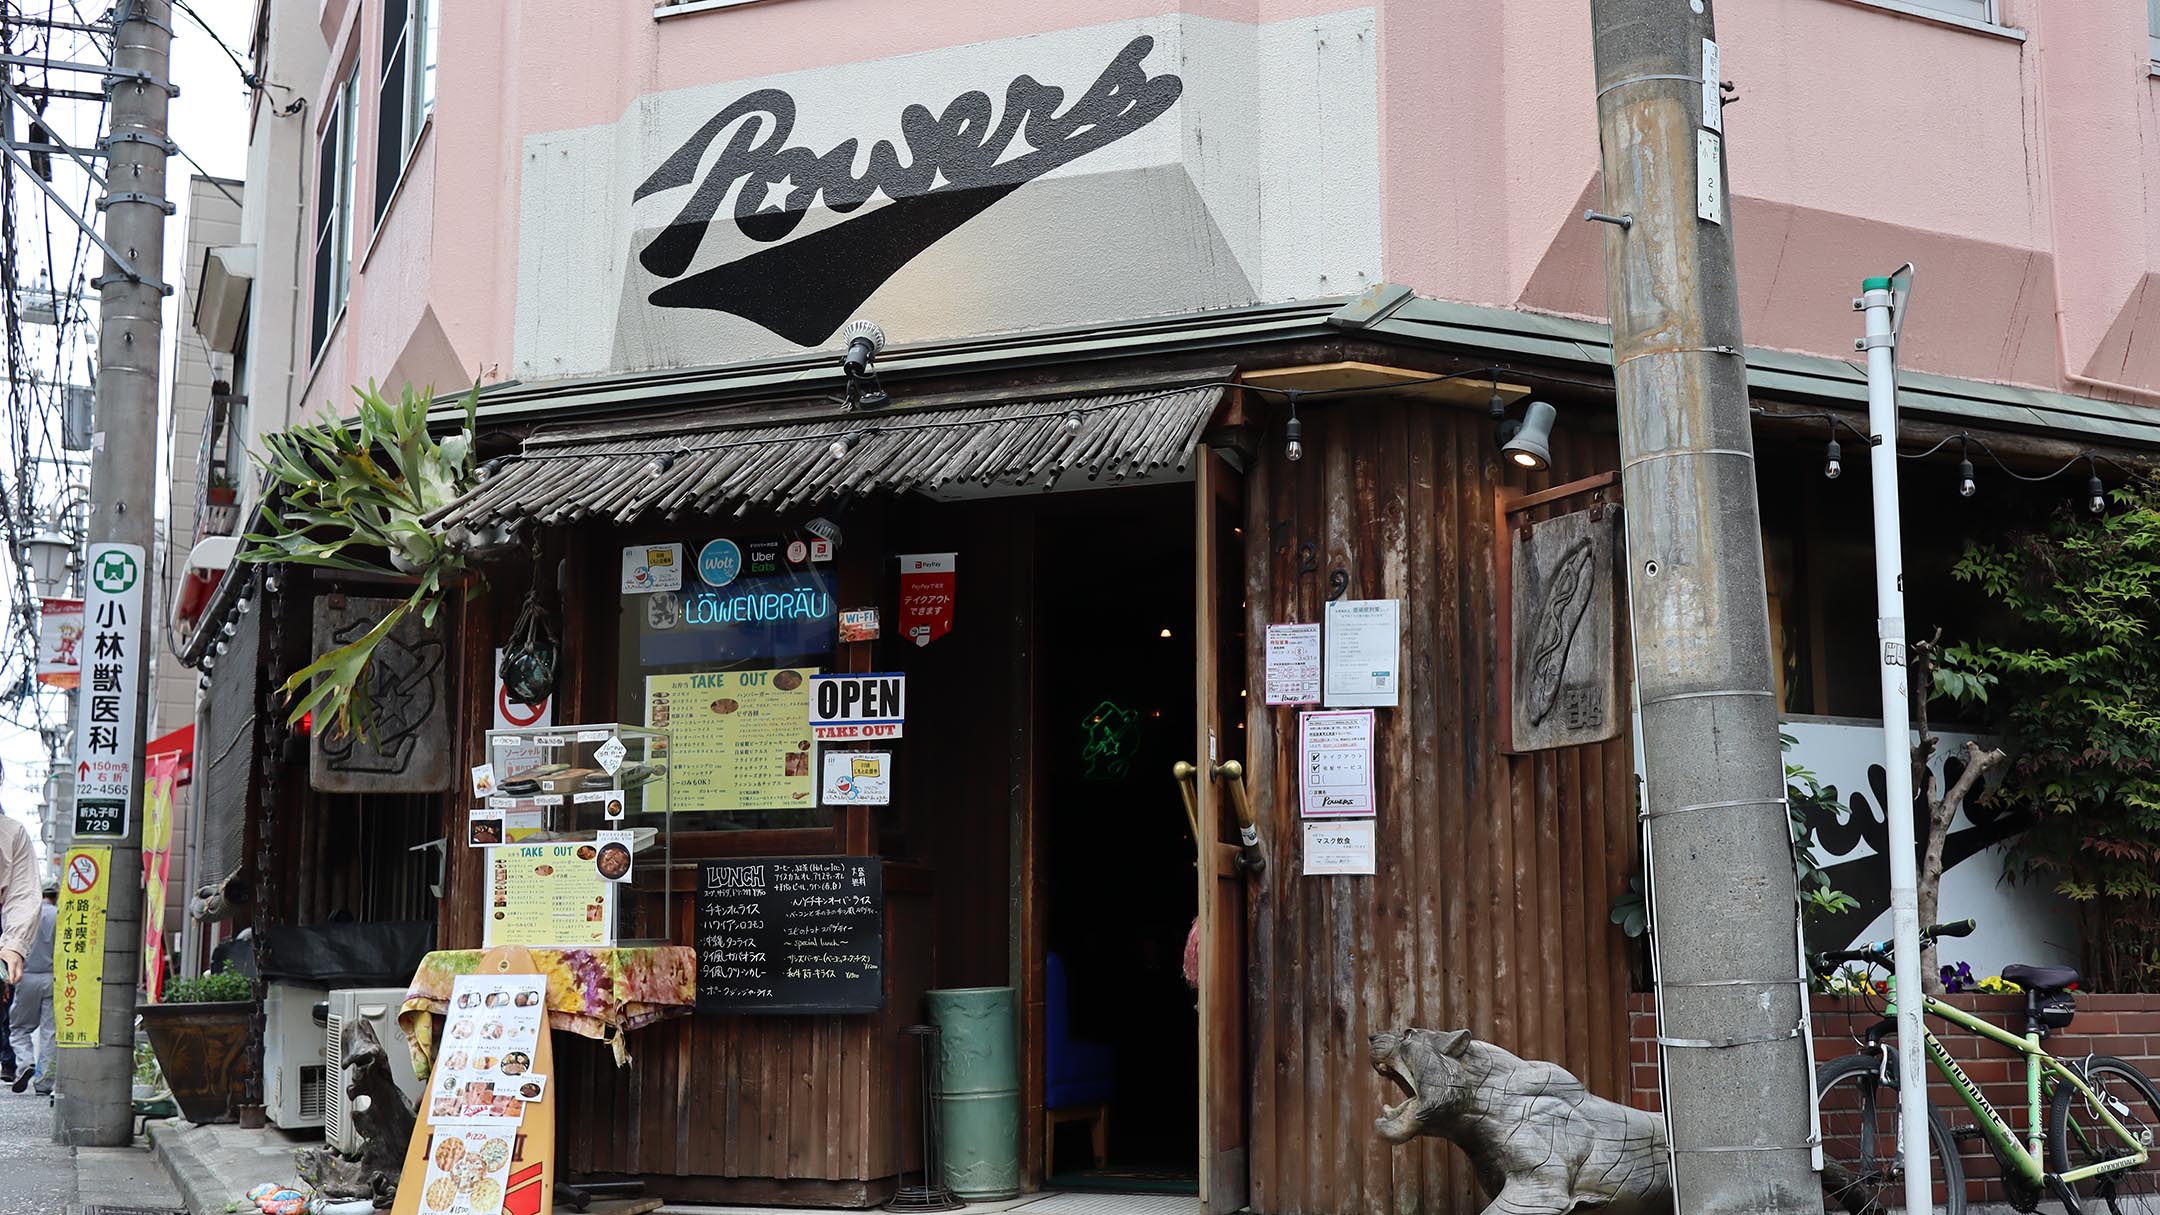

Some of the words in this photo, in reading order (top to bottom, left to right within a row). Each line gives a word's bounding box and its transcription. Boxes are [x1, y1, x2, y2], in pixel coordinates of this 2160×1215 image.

[632, 34, 1182, 277] Powers
[705, 557, 734, 569] Wolt
[751, 552, 775, 562] Uber
[751, 563, 775, 572] Eats
[905, 594, 950, 604] テイクアウト
[685, 587, 827, 625] LÖWENBRÄU
[910, 606, 942, 616] できます
[846, 611, 873, 623] WI-FI
[88, 600, 127, 756] 小林獣医科
[690, 674, 724, 689] TAKE
[740, 672, 768, 686] OUT
[818, 679, 900, 719] OPEN
[816, 726, 858, 738] TAKE
[862, 725, 895, 736] OUT
[92, 761, 129, 772] 150m先
[77, 784, 128, 795] 722-4565
[80, 807, 119, 818] 新丸子町
[86, 820, 110, 831] 729
[1316, 837, 1351, 845] マスク飲食
[520, 847, 543, 857] TAKE
[554, 846, 573, 857] OUT
[706, 865, 766, 888] LUNCH
[63, 899, 75, 953] ポイ捨て
[74, 899, 89, 953] 路上喫煙
